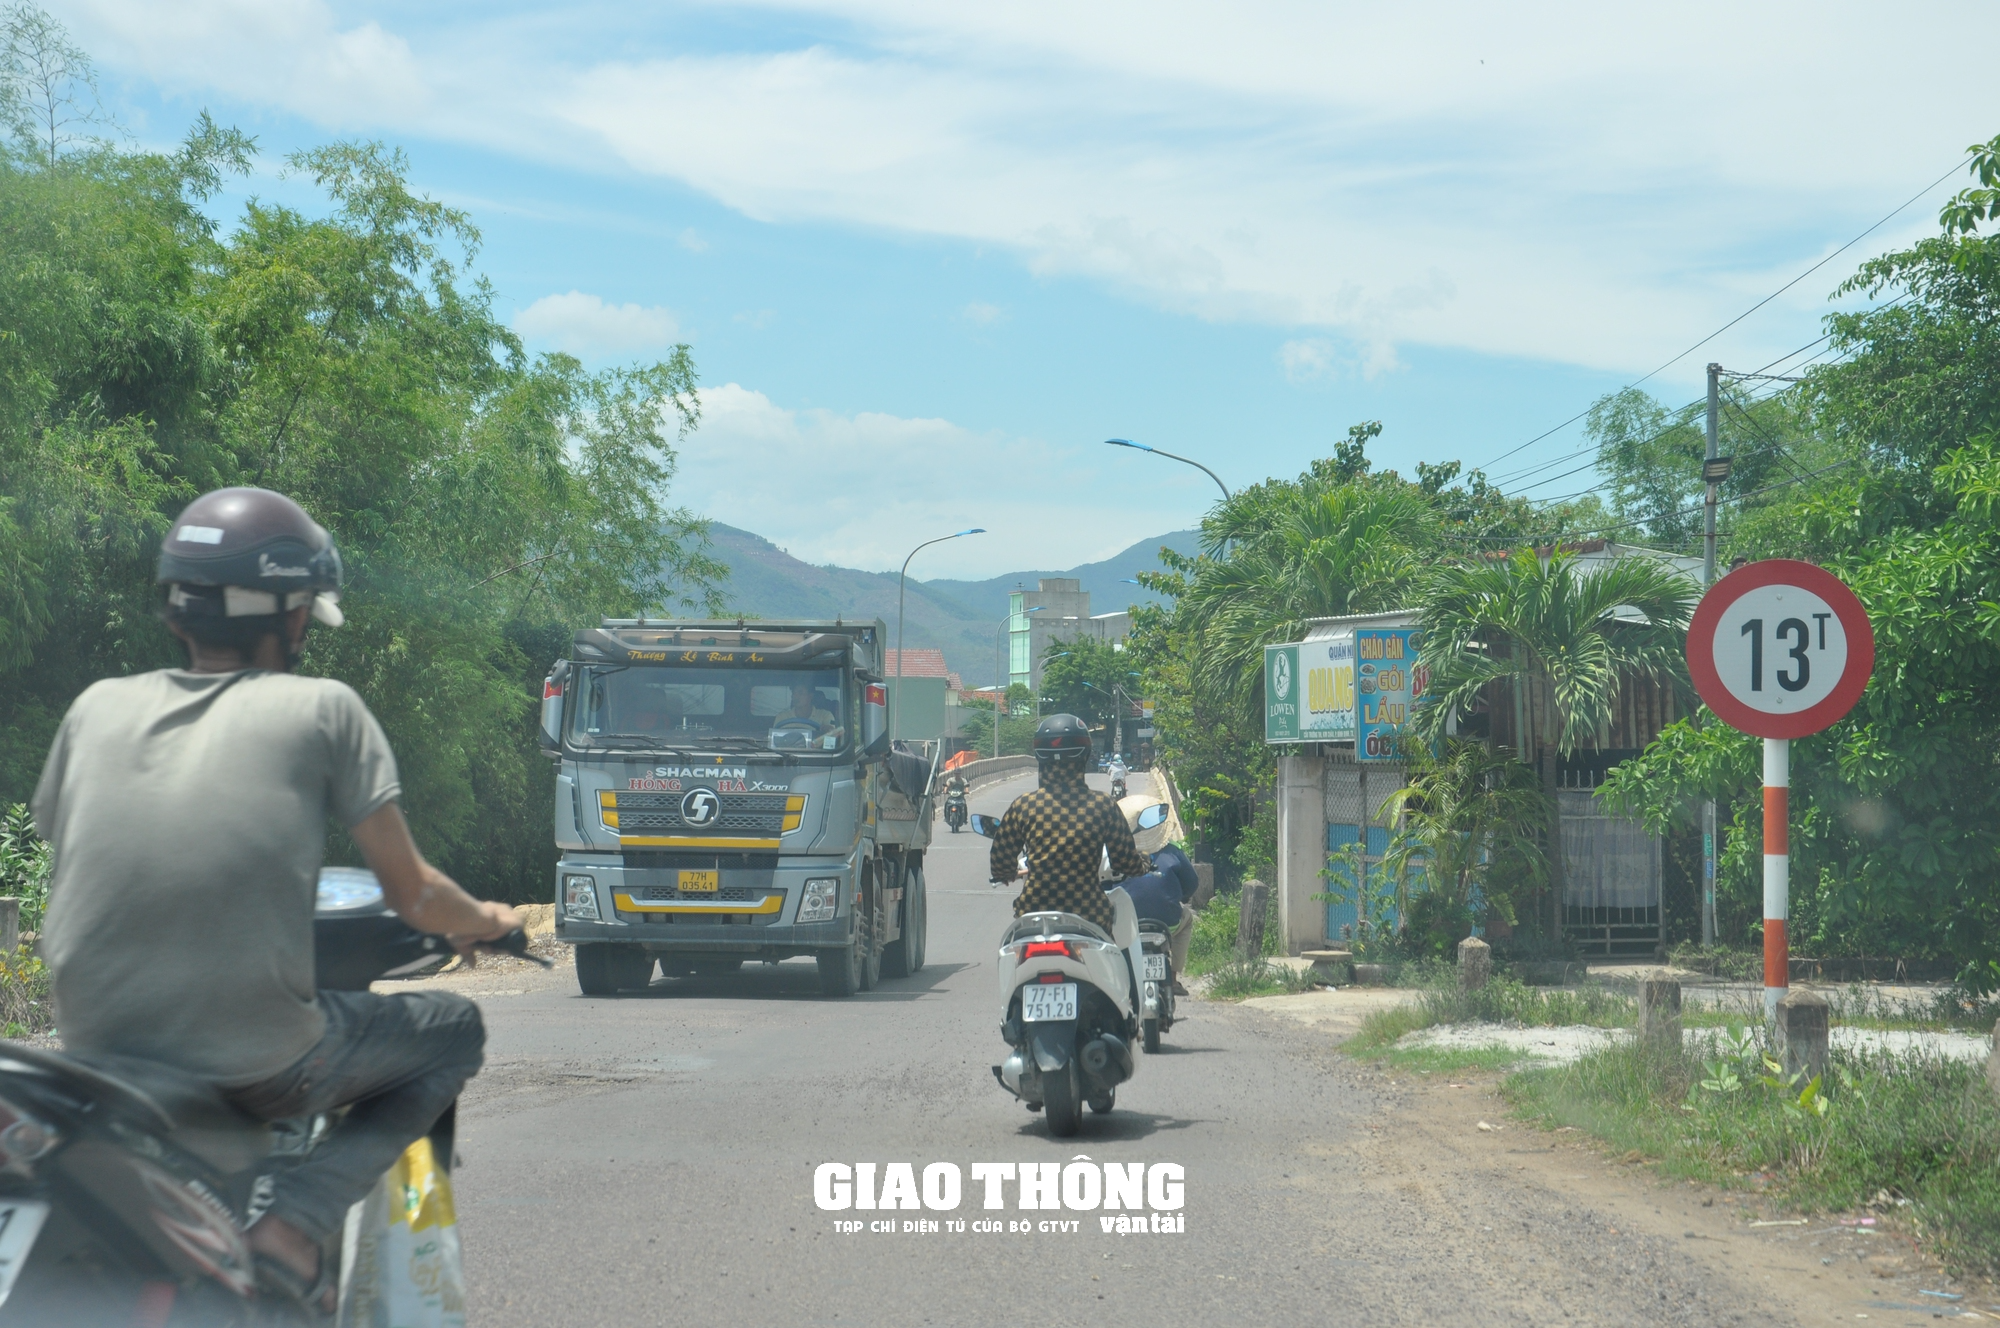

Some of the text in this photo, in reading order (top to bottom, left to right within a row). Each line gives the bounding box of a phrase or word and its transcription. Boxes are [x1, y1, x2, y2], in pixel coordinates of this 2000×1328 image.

[1328, 643, 1347, 660] QUÁN
[1360, 633, 1383, 659] CHÁO
[745, 652, 763, 663] An
[1377, 664, 1404, 691] GỎI
[1308, 665, 1354, 714] QUANG
[1364, 696, 1405, 724] LẨU
[628, 770, 681, 791] HỒNG
[655, 766, 746, 779] SHACMAN
[717, 777, 748, 793] HÀ
[749, 780, 788, 791] X3000
[690, 872, 707, 881] 77H
[682, 881, 713, 891] 035.41
[1145, 967, 1164, 979] 6.27
[1031, 986, 1067, 1003] 77-F1
[1026, 1002, 1073, 1019] 751.28
